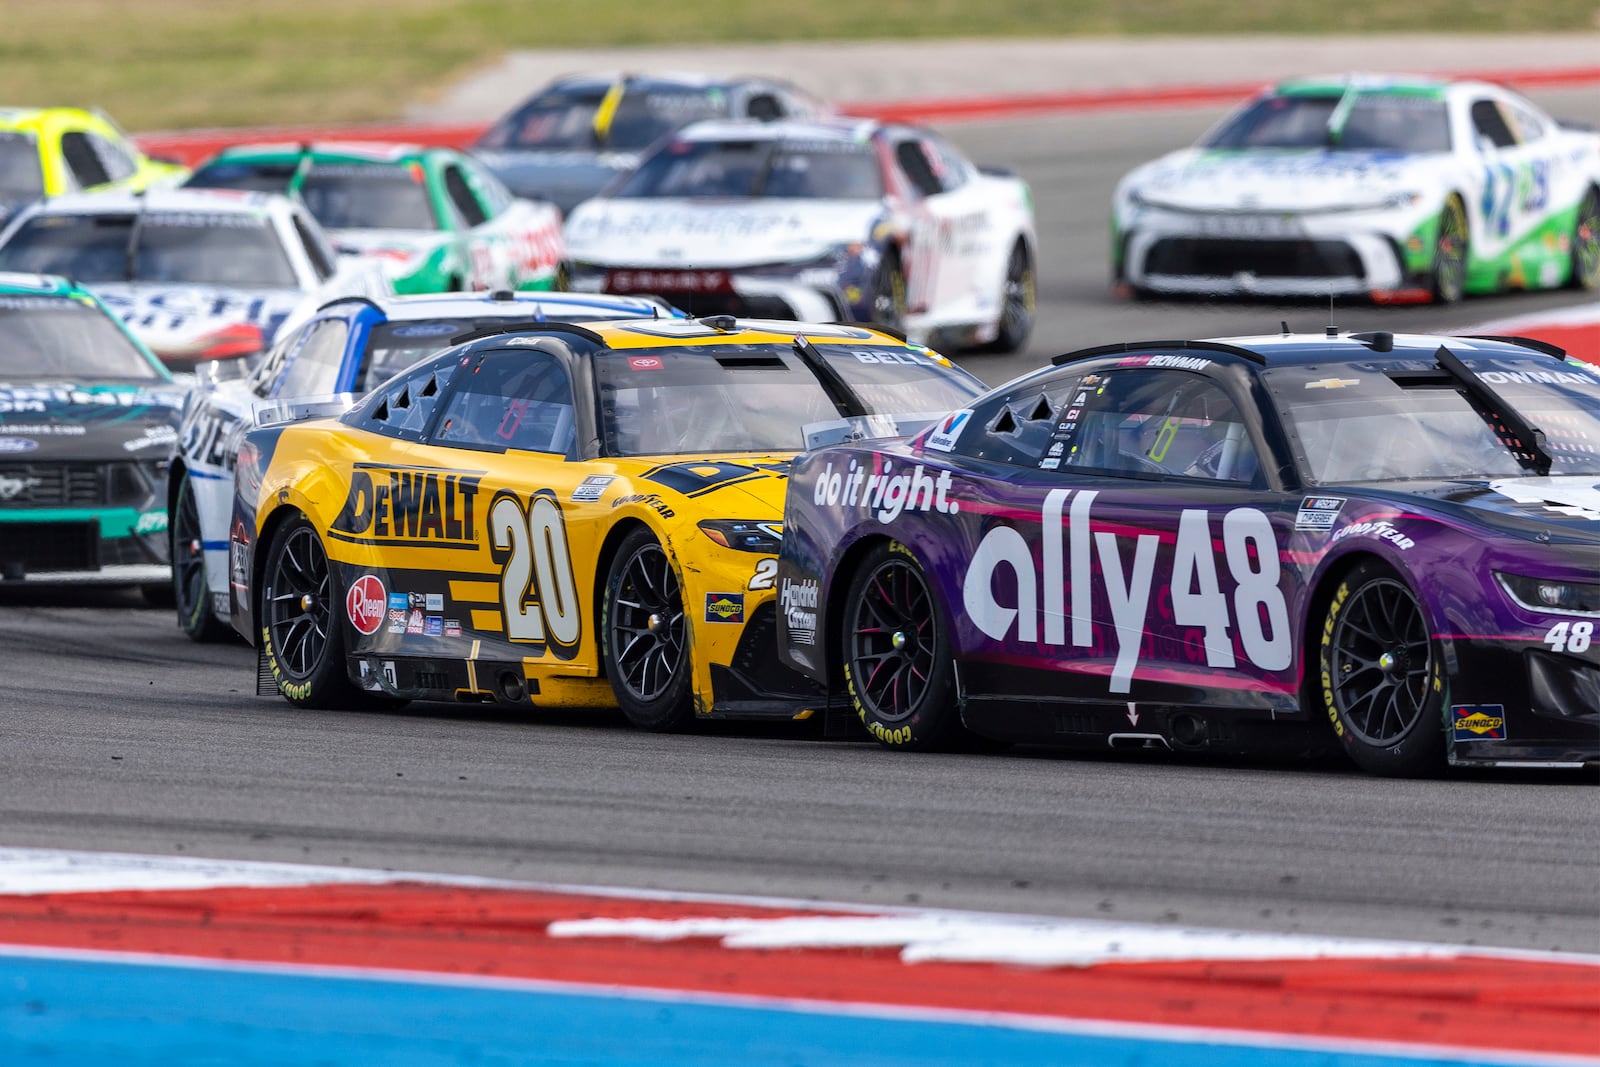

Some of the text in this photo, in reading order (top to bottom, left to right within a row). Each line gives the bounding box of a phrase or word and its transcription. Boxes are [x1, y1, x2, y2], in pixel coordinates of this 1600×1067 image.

[852, 351, 934, 366] BELL
[1146, 355, 1212, 370] BOWMAN
[1473, 371, 1598, 385] OWMAN
[331, 471, 481, 542] DEWALT
[814, 463, 842, 507] do
[843, 458, 865, 508] it
[863, 462, 960, 525] right.
[1332, 520, 1416, 550] GOODYEAR
[489, 490, 581, 649] 20
[353, 577, 384, 625] Rheem
[963, 489, 1293, 694] ally 48
[707, 603, 742, 615] SUNOCO
[1543, 621, 1594, 653] 48
[1456, 718, 1503, 730] SUNOCO
